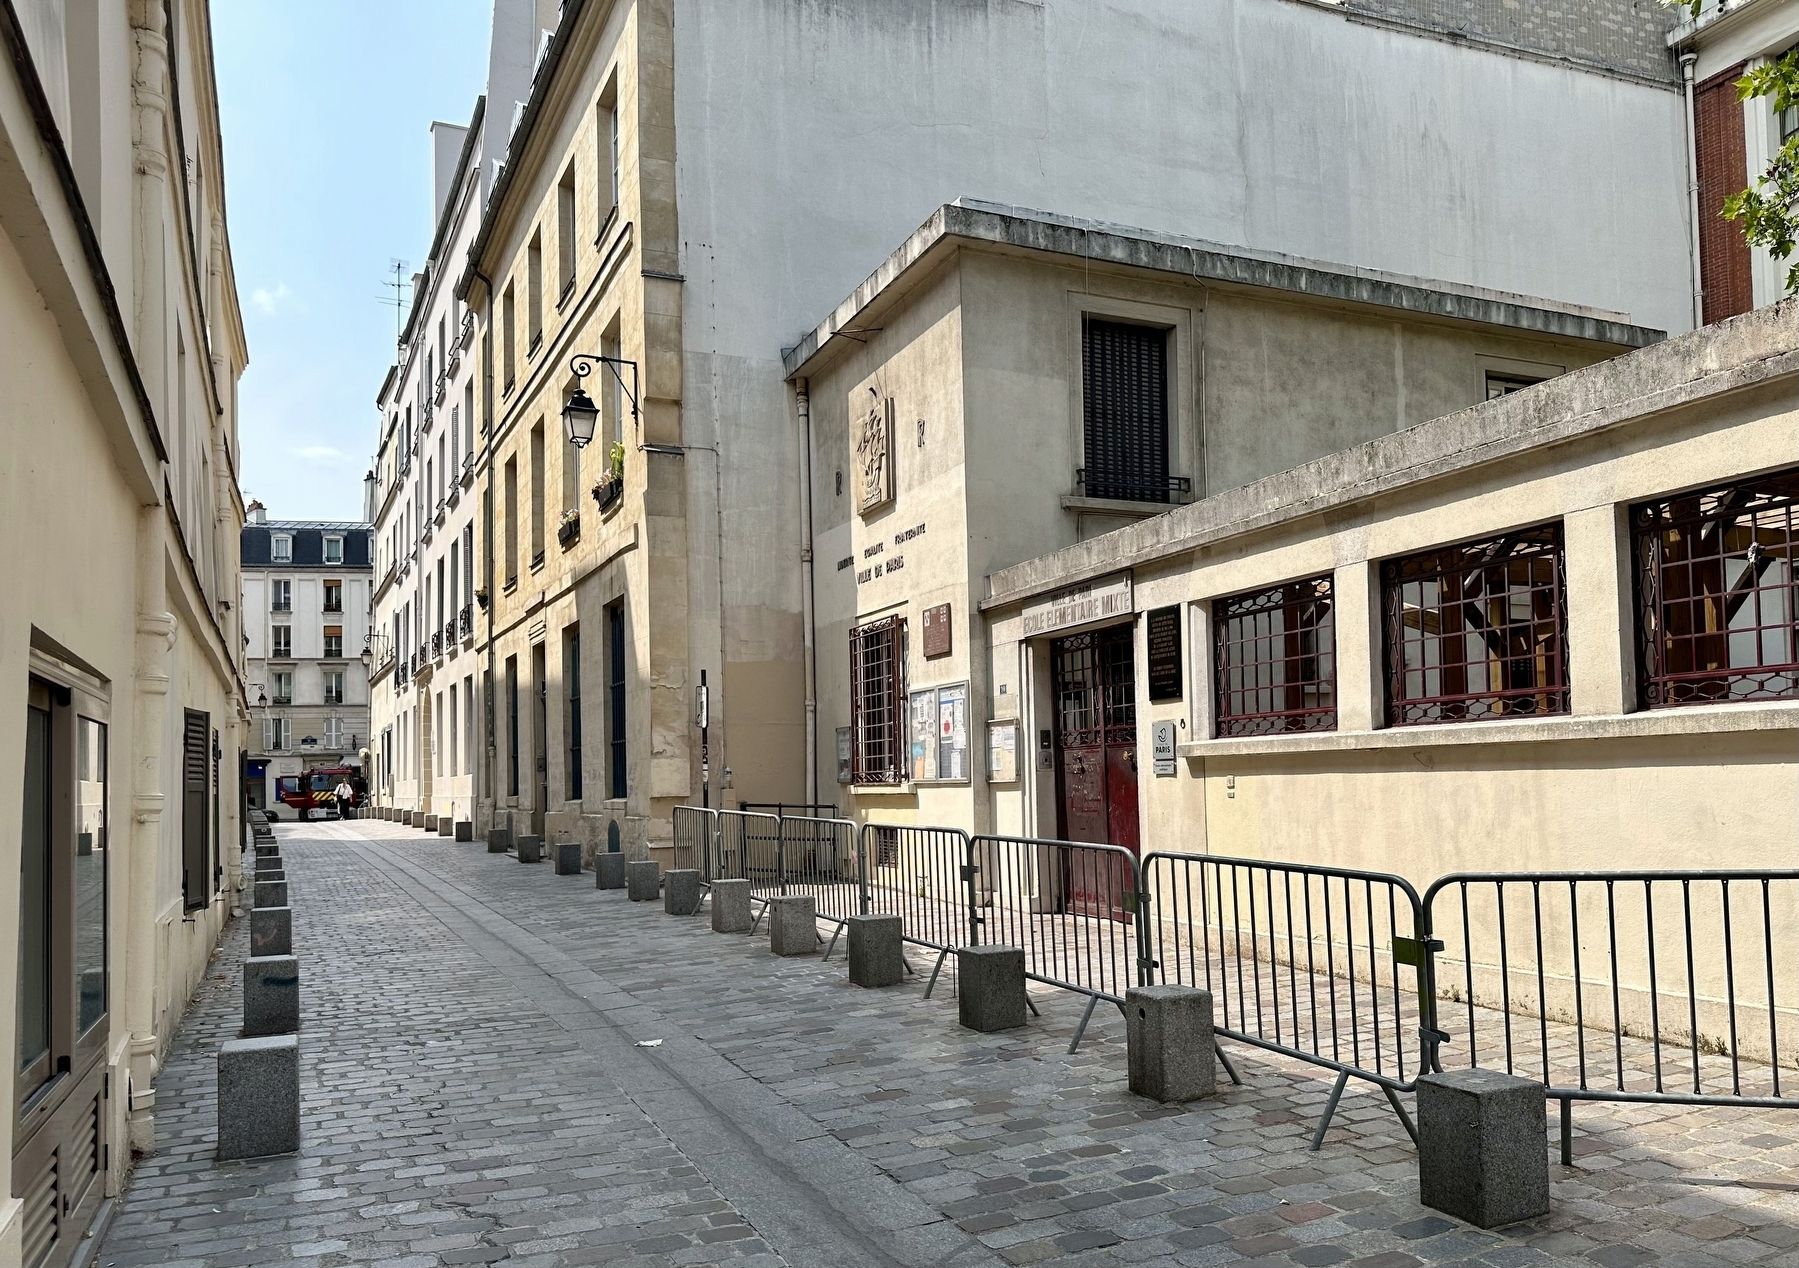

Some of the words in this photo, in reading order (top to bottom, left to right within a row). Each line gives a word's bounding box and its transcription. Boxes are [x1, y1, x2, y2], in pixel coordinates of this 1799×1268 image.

[857, 568, 872, 585] VILLE
[875, 565, 883, 579] DE
[886, 555, 904, 574] PARIS
[1024, 612, 1044, 634] ECOLE
[1047, 598, 1099, 629] ELEMENTAIRE
[1102, 591, 1130, 616] MIXTE
[1156, 745, 1171, 754] PARIS
